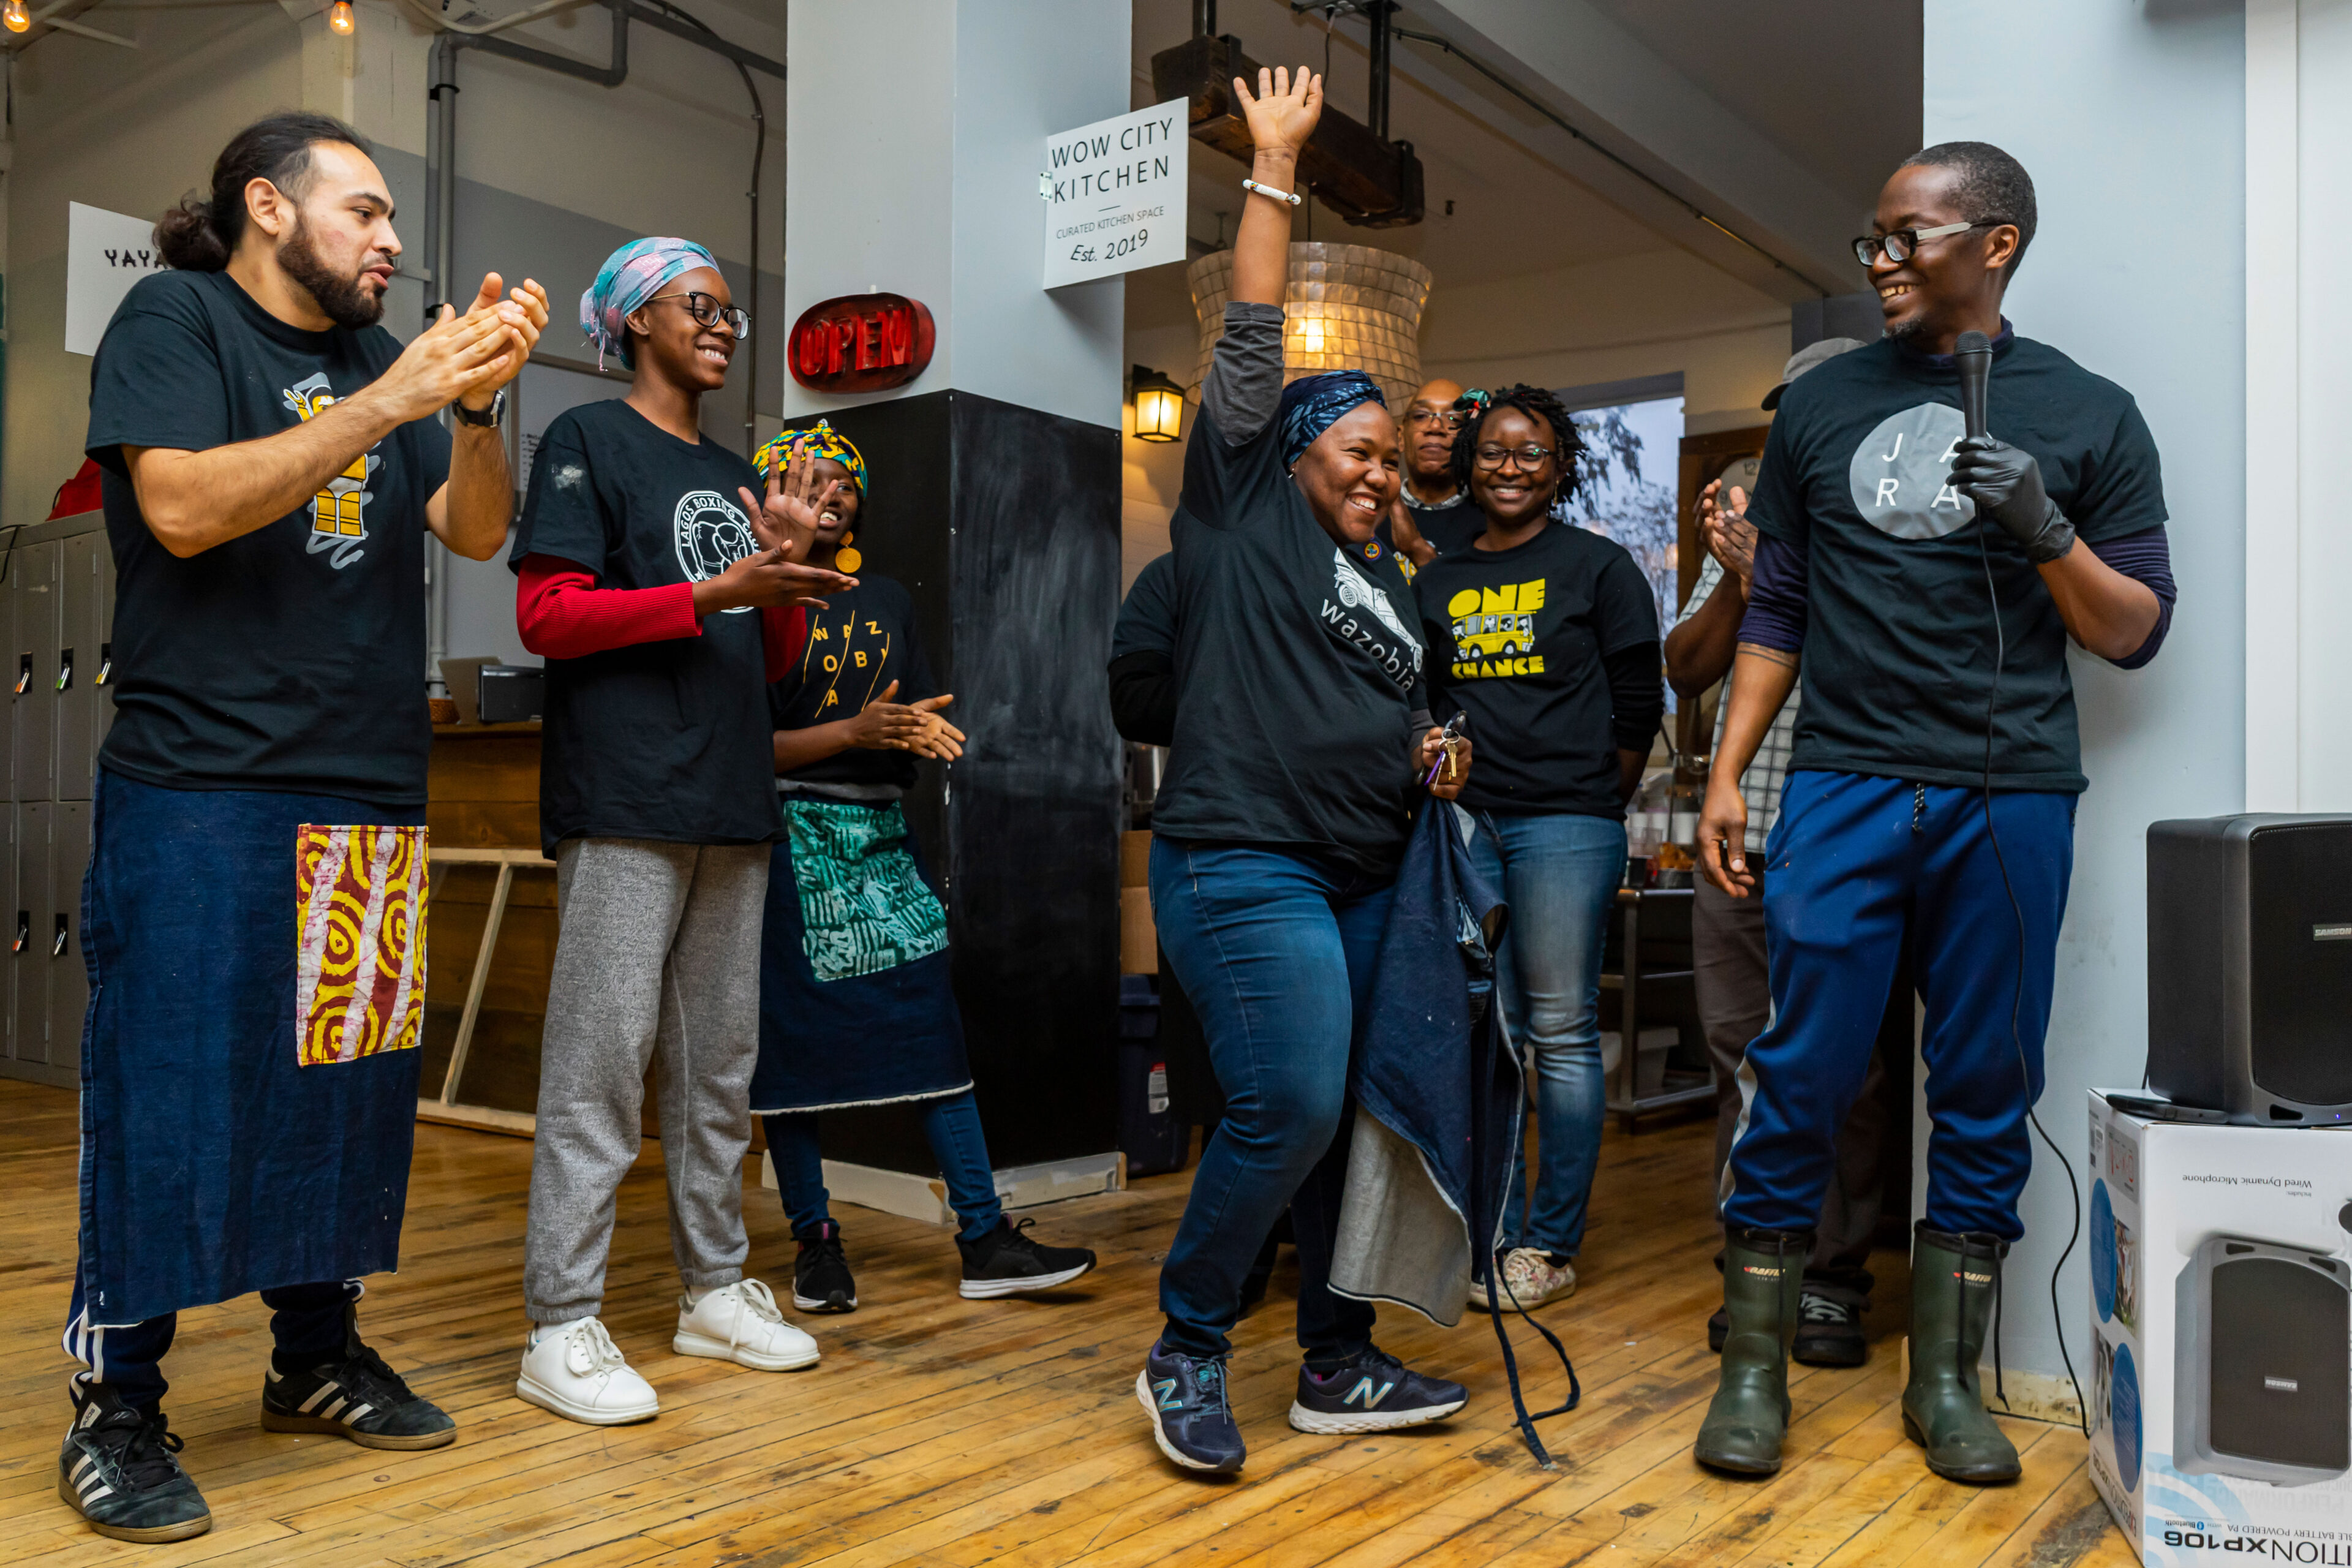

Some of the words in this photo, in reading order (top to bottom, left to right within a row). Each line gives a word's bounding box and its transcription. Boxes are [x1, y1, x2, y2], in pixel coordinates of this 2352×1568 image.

[1052, 134, 1110, 168] WOW
[1121, 118, 1172, 151] CITY
[1055, 156, 1168, 203] KITCHEN
[1057, 222, 1095, 239] CURATED
[1098, 213, 1134, 230] KITCHEN
[1137, 206, 1164, 221] SPACE
[1070, 245, 1097, 262] Est.
[1104, 228, 1148, 260] 2019
[799, 307, 913, 375] OPEN
[680, 504, 695, 548] LAGOS
[1448, 578, 1545, 617] ONE
[1452, 655, 1545, 679] CHANCE
[2315, 927, 2351, 937] SAMSON
[2182, 1174, 2237, 1185] Microphone
[2241, 1176, 2281, 1187] Dynamic
[2285, 1179, 2312, 1188] Wired
[1343, 1376, 1395, 1409] N
[2165, 1520, 2196, 1528] Bluetooth
[2242, 1525, 2290, 1536] POWERED
[2294, 1528, 2334, 1539] BATTERY
